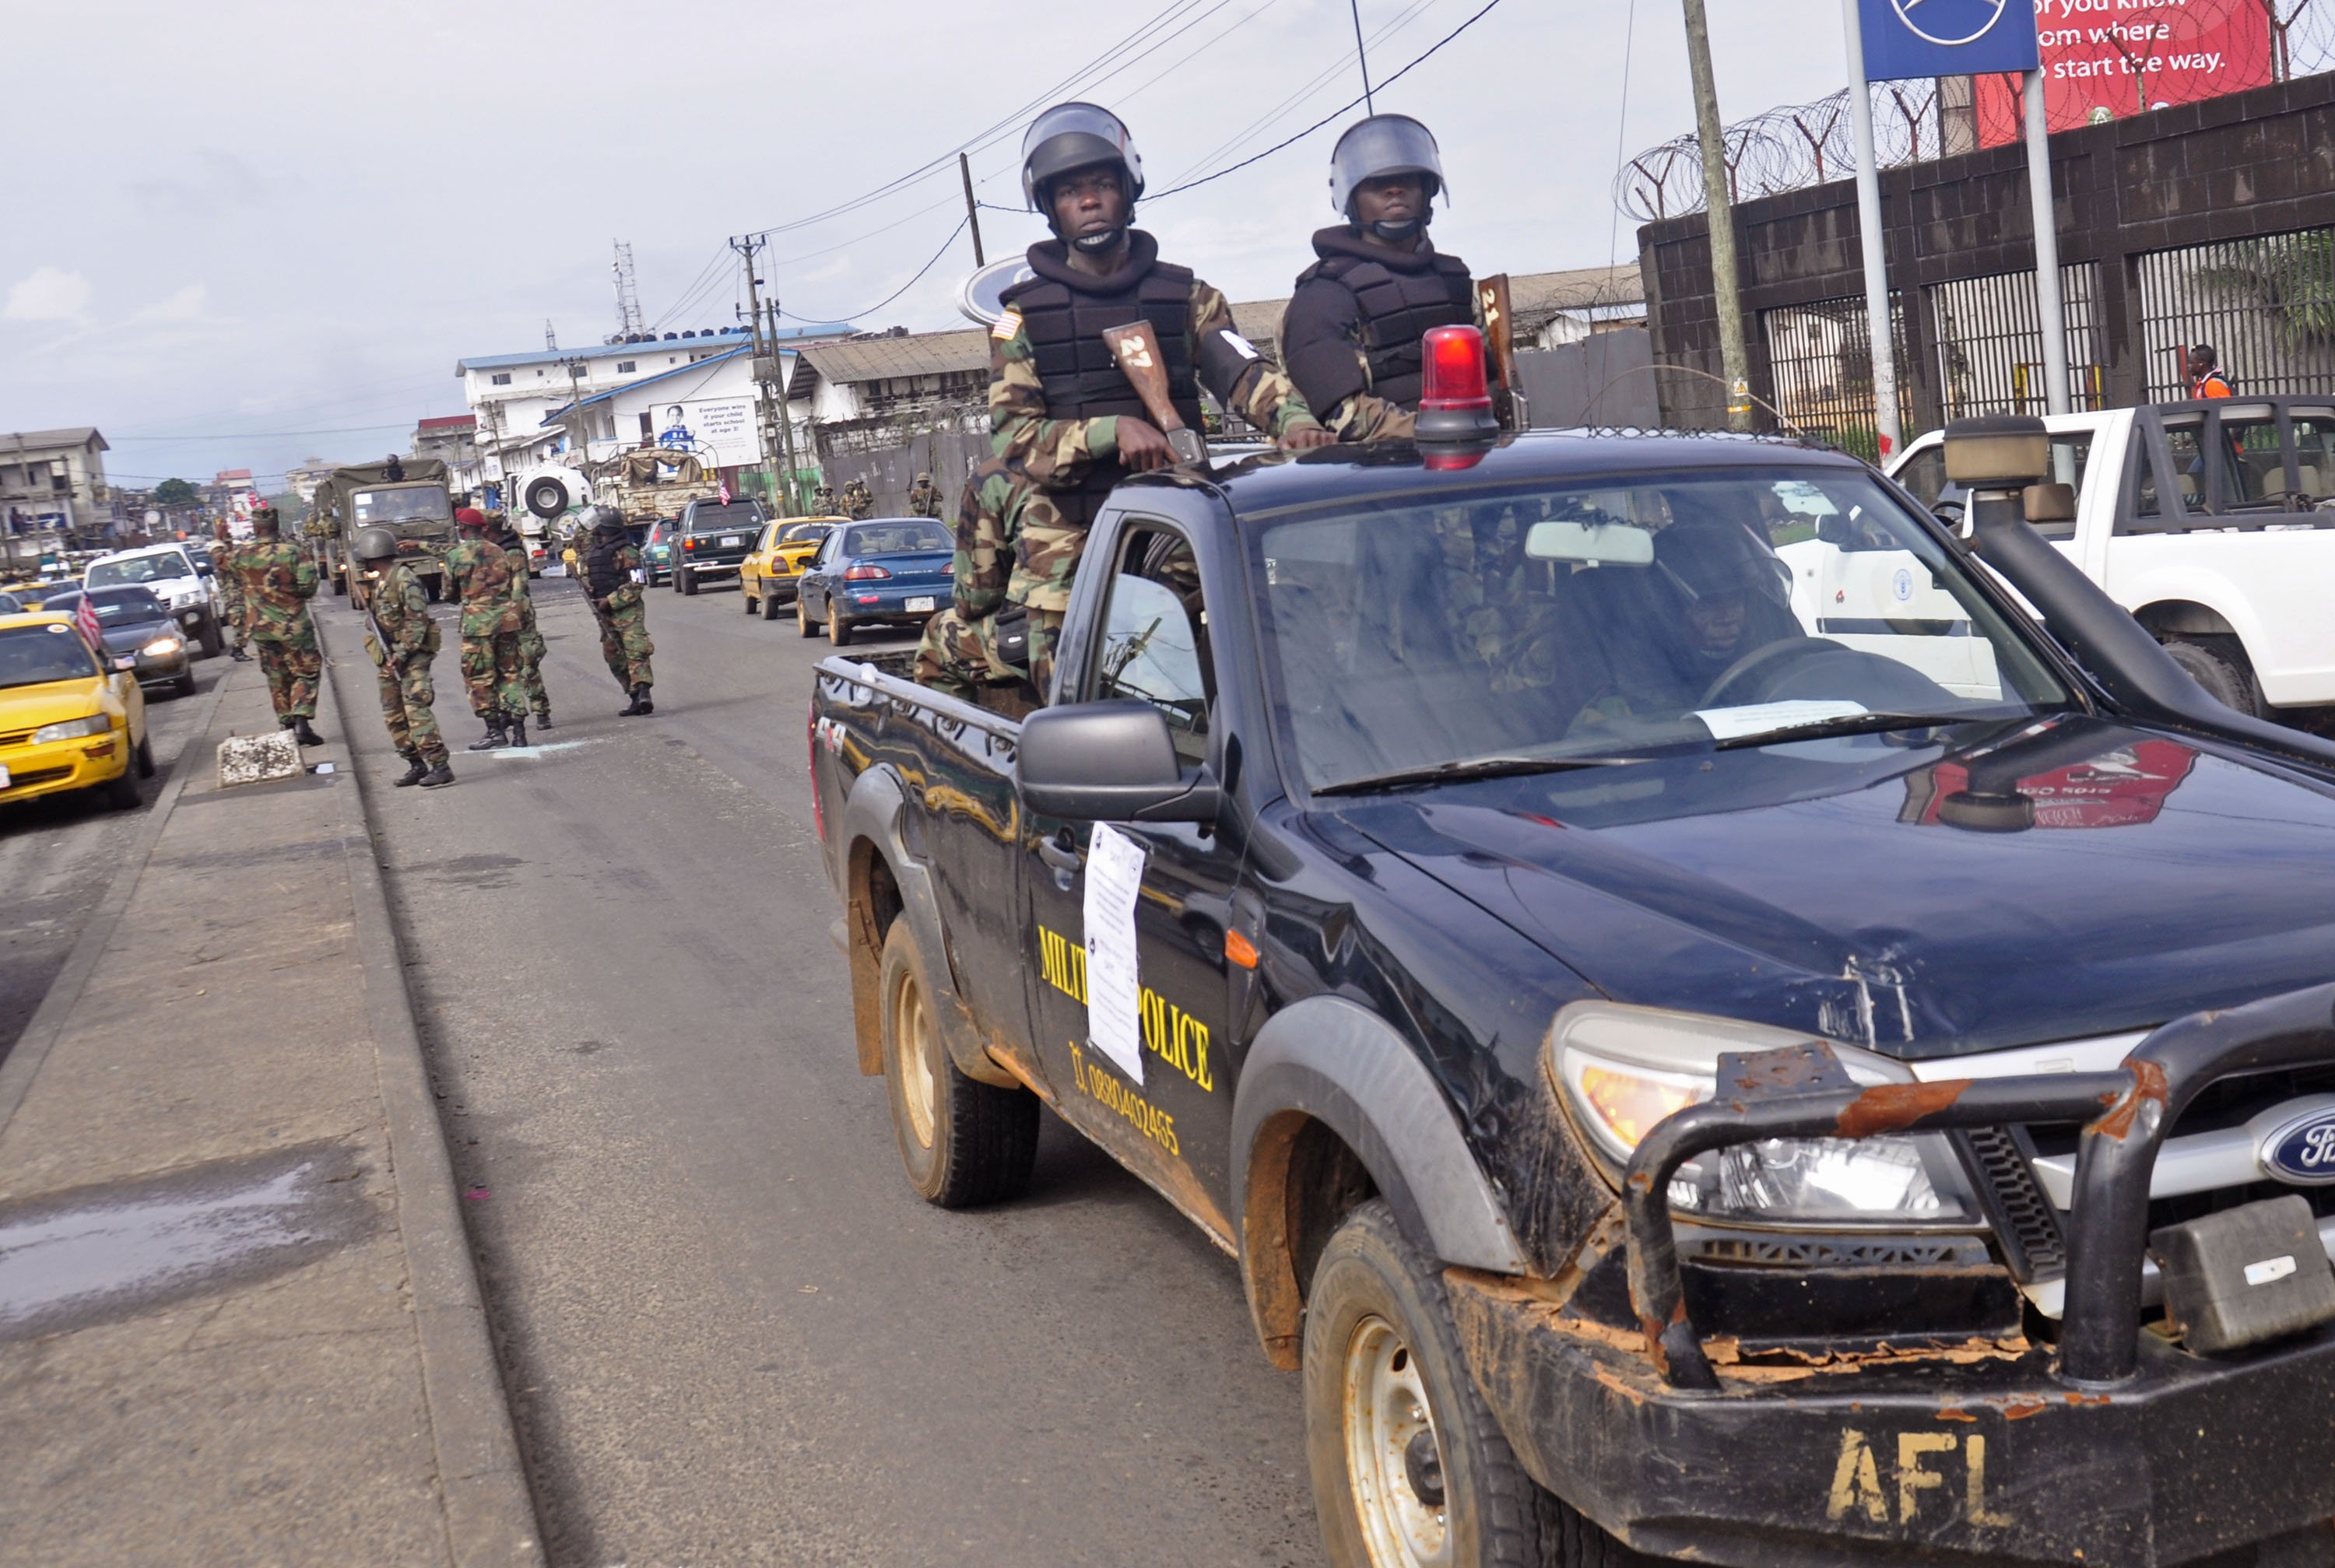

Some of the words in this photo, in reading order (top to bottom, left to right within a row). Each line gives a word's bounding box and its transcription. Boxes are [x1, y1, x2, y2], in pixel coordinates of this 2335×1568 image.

[2088, 21, 2170, 44] where
[2054, 58, 2113, 79] start
[2119, 52, 2163, 75] the
[2168, 51, 2226, 74] way.
[1120, 335, 1153, 367] 27
[1826, 1427, 2017, 1527] AFL
